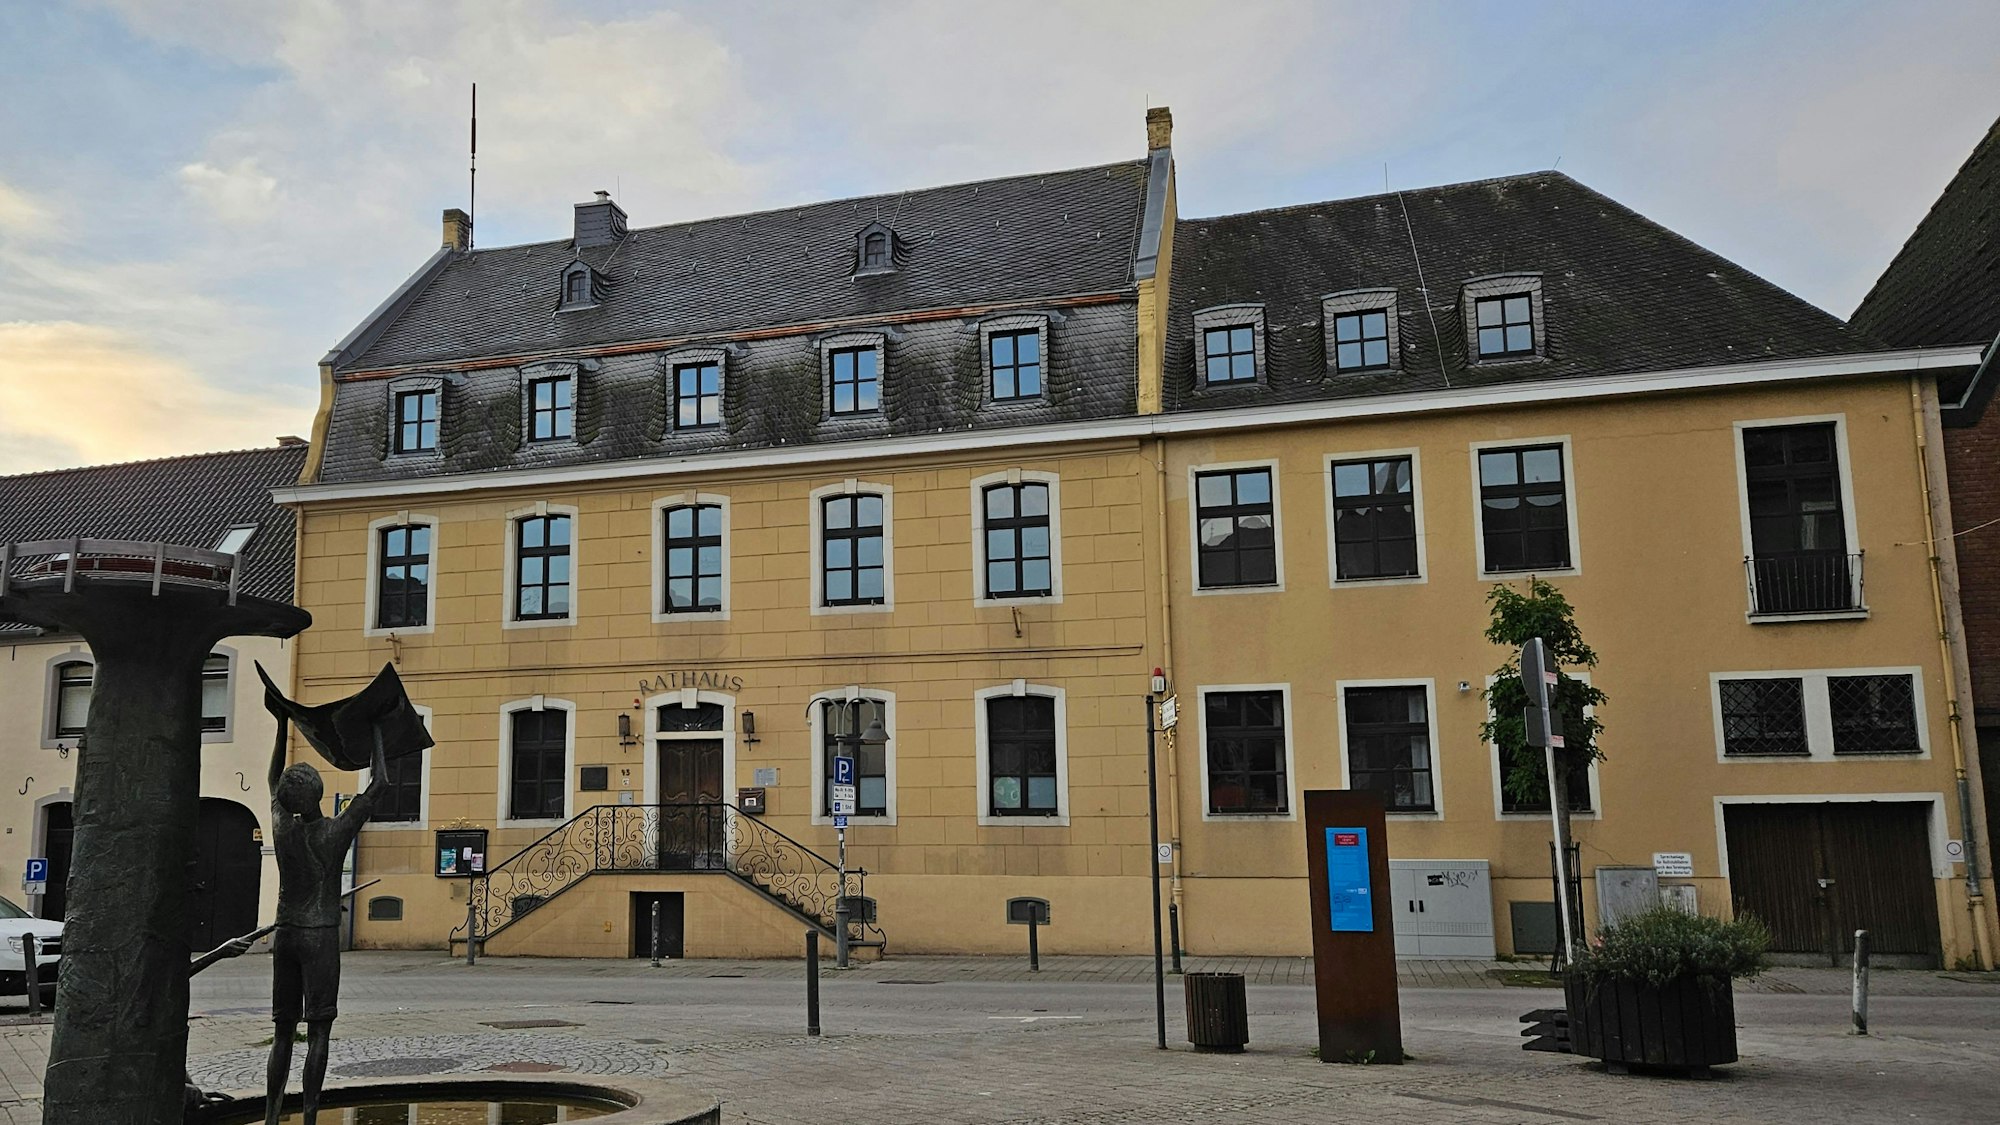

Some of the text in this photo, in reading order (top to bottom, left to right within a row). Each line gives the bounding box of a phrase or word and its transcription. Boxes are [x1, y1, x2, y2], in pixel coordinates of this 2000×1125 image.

[639, 671, 743, 695] RATHAUS
[838, 760, 849, 781] P
[31, 861, 42, 879] P
